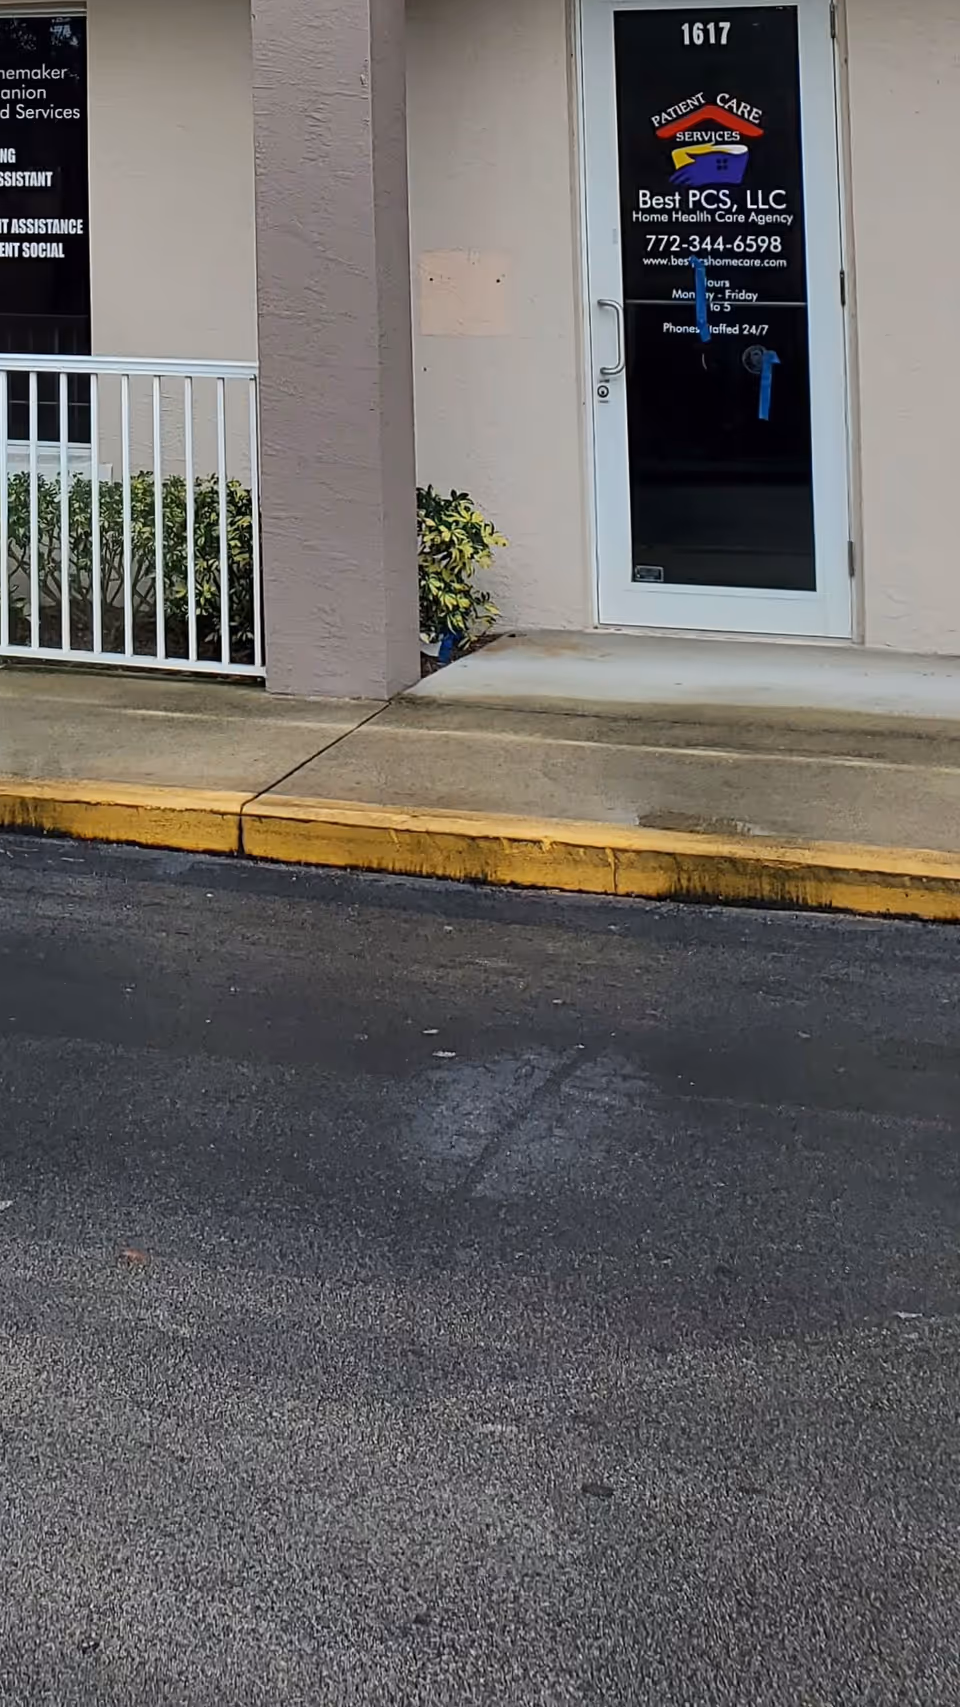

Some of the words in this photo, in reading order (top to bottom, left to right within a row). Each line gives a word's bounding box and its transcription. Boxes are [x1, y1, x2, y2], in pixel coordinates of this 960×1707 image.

[681, 22, 731, 45] 1617
[16, 104, 80, 119] Services
[651, 92, 706, 127] PATIENT
[716, 93, 762, 124] CARE
[676, 131, 740, 144] SERVICES
[639, 190, 681, 209] Best
[689, 190, 738, 212] PCS,
[747, 190, 787, 209] LLC
[632, 211, 668, 222] Home
[673, 211, 711, 222] Health
[715, 211, 745, 222] Care
[749, 212, 793, 225] Agency
[11, 219, 83, 234] ASSISTANCE
[22, 243, 65, 258] SOCIAL
[646, 235, 782, 252] 772-344-6598
[643, 255, 787, 268] www.besshomecare.com
[704, 278, 730, 287] ours
[672, 289, 715, 301] Mony
[725, 290, 758, 302] Friday
[723, 302, 730, 312] 5
[663, 323, 700, 333] Phones
[709, 324, 739, 334] taffed
[743, 325, 768, 335] 24/7
